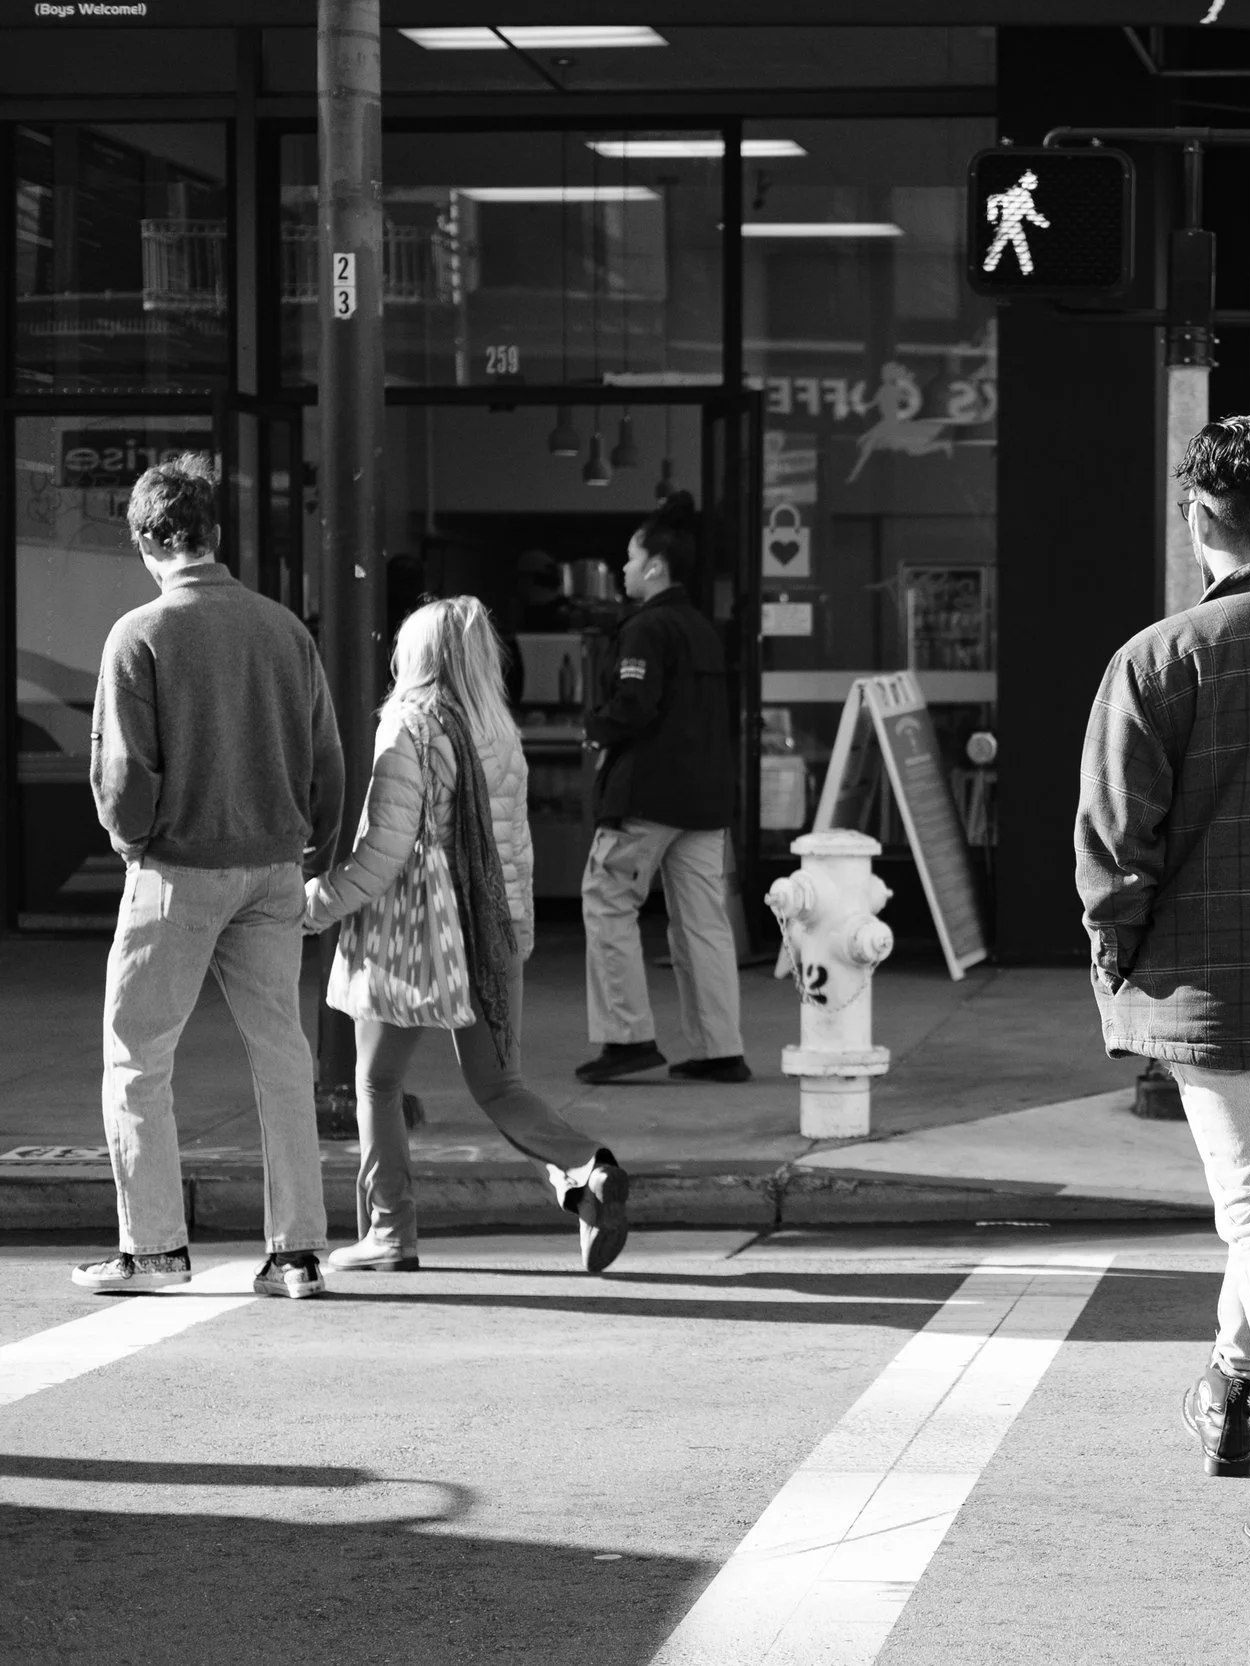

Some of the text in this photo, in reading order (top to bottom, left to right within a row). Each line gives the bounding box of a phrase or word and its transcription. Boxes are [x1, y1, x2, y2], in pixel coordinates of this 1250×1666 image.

[34, 3, 147, 18] (Boys Welcome!)
[485, 345, 519, 374] 259
